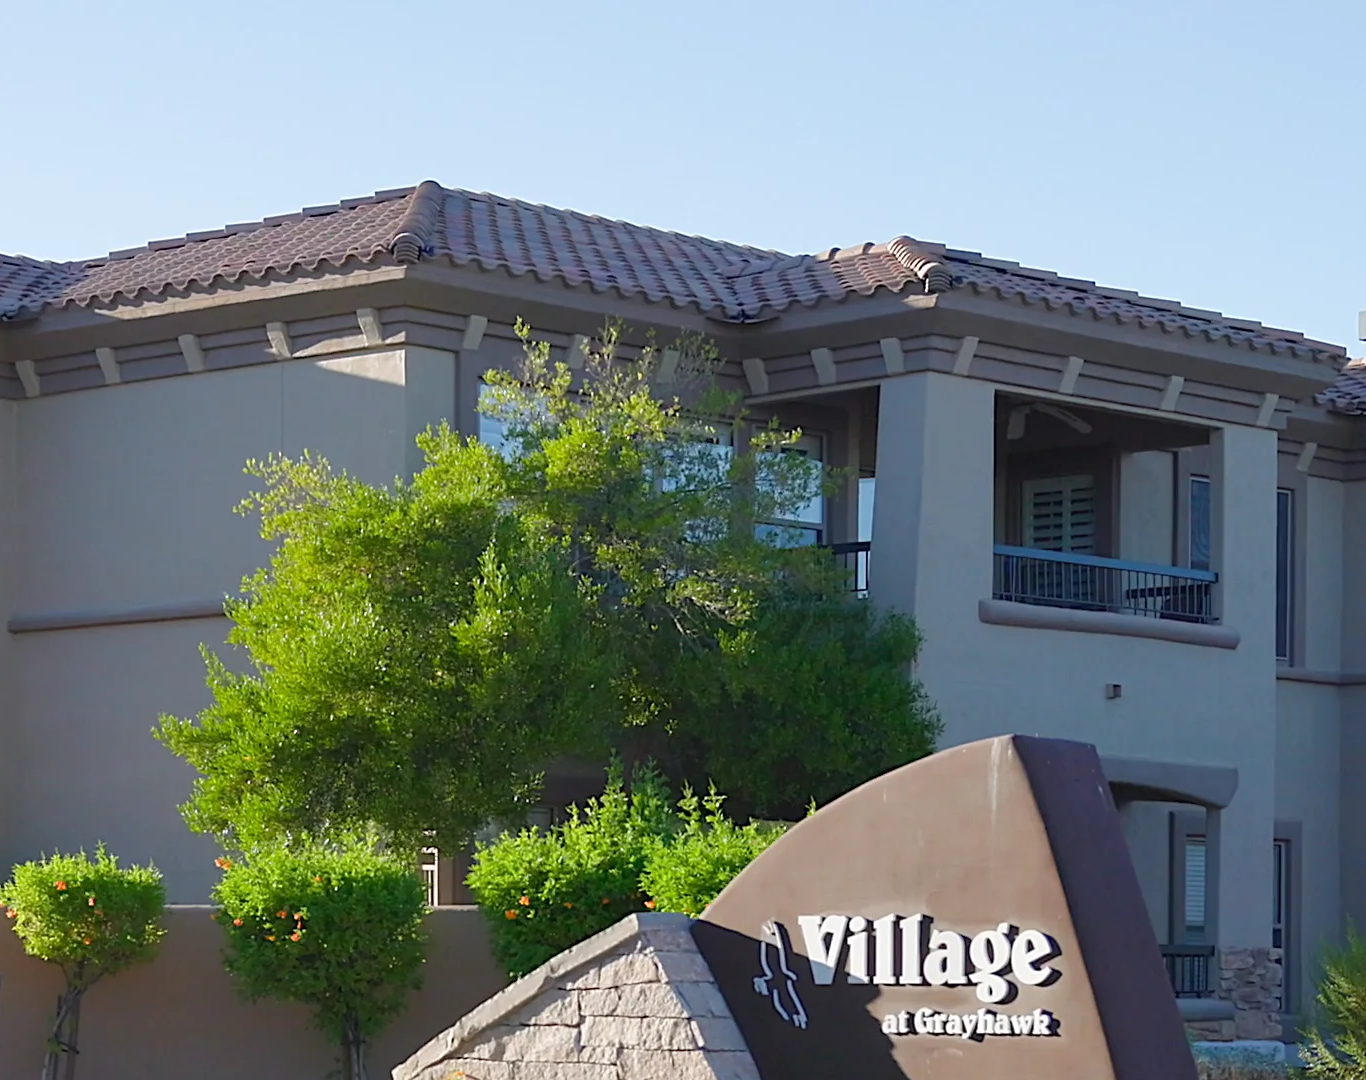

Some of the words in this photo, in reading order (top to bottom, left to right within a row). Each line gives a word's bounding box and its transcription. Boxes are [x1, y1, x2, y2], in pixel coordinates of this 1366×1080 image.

[798, 913, 1052, 1003] Village
[882, 1011, 908, 1034] at
[913, 1007, 1052, 1039] Grayhawk
